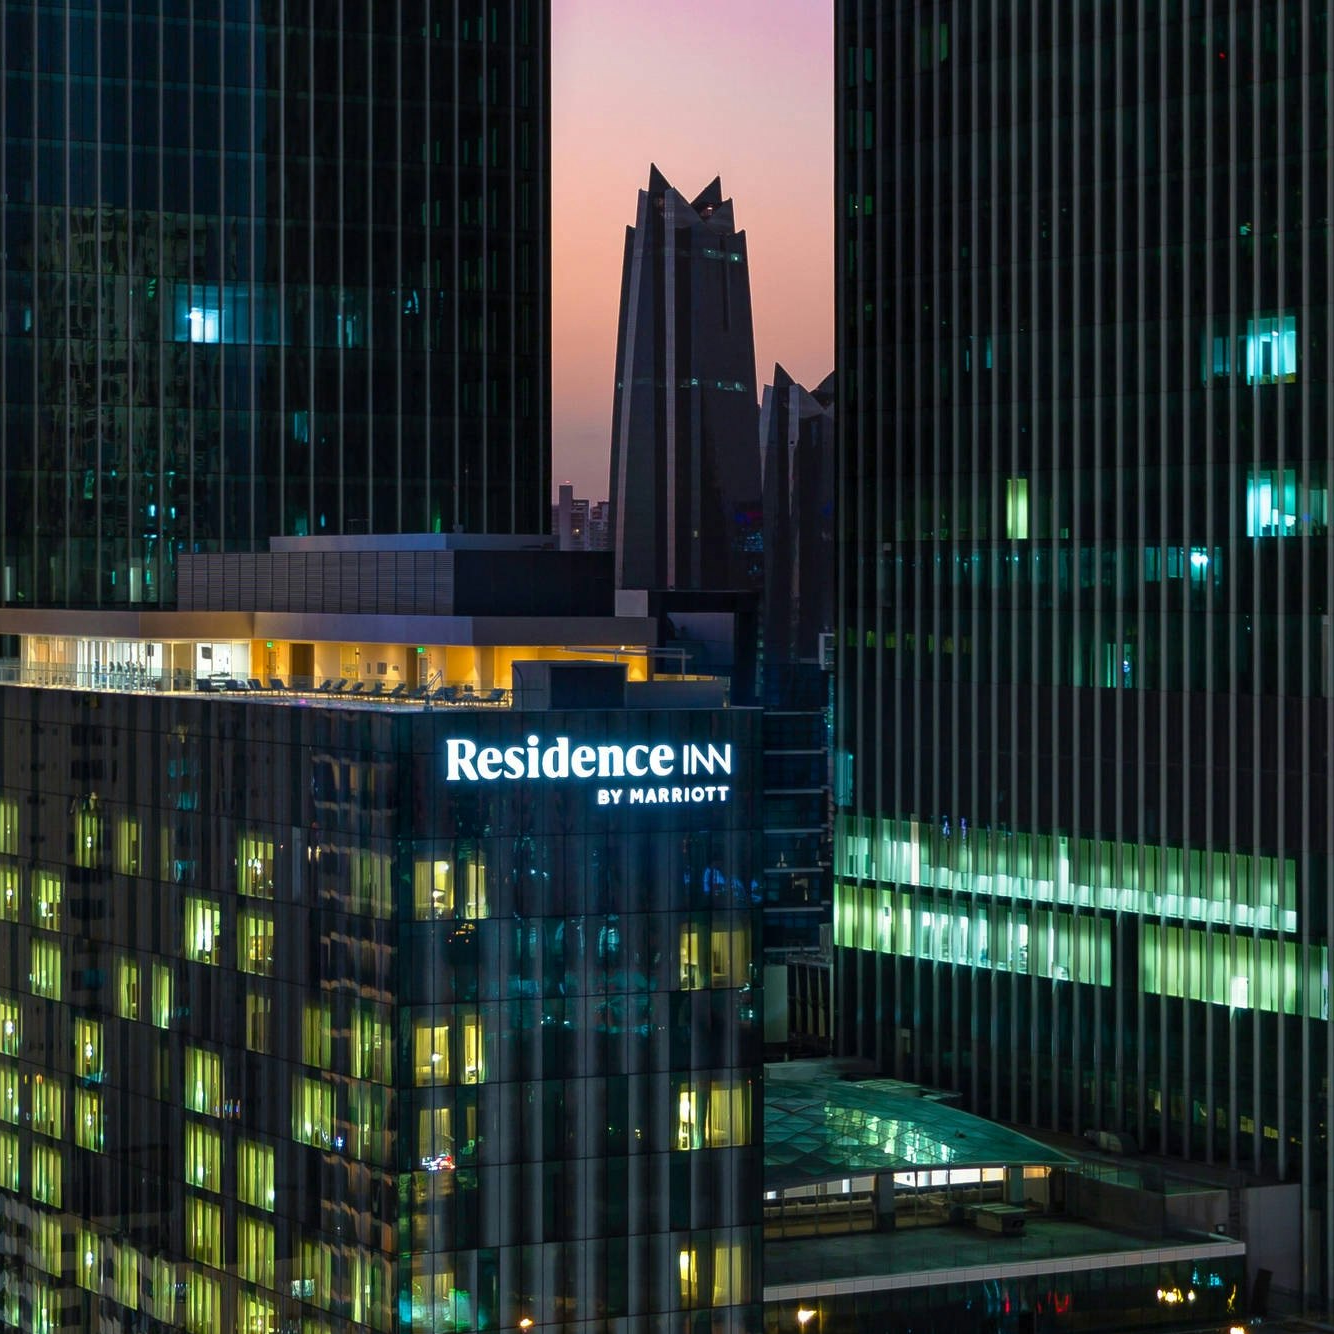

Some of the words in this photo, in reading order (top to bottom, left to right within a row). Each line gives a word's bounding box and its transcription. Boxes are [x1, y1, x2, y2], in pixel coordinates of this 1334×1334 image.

[446, 735, 674, 781] Residence
[683, 744, 731, 775] INN
[597, 788, 622, 805] BY
[630, 786, 729, 804] MARRIOTT
